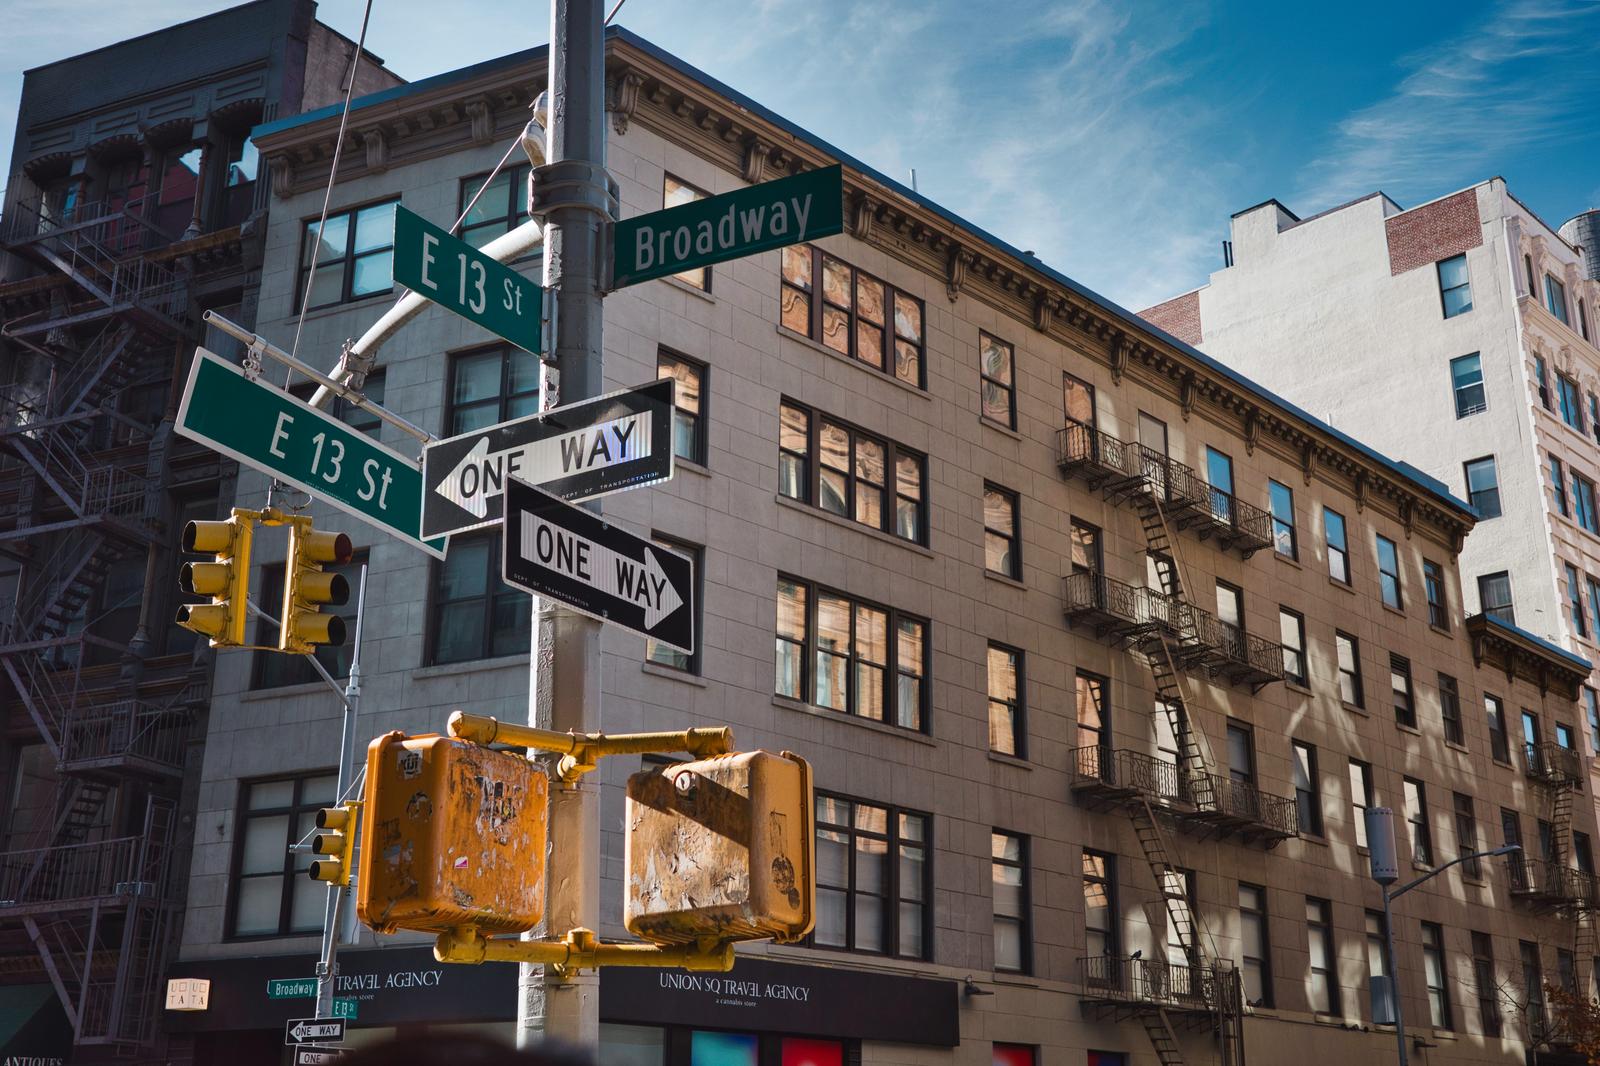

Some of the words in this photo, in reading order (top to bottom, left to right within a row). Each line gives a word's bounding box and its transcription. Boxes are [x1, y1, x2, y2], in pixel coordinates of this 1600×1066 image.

[634, 193, 812, 272] Broadway
[421, 231, 439, 291] E
[458, 252, 487, 315] 13
[503, 277, 523, 316] St
[269, 411, 295, 459] E
[310, 432, 345, 484] 13
[356, 458, 393, 511] St
[459, 450, 525, 499] ONE
[560, 419, 637, 474] WAY
[536, 524, 591, 582] ONE
[615, 557, 667, 611] WAY
[275, 983, 314, 997] Broadway
[660, 972, 702, 991] UNION
[704, 977, 721, 994] SQ
[295, 1026, 312, 1037] ONE
[319, 1025, 337, 1036] WAY
[335, 1001, 340, 1015] E
[341, 1001, 348, 1016] 13
[304, 1053, 321, 1064] ONE
